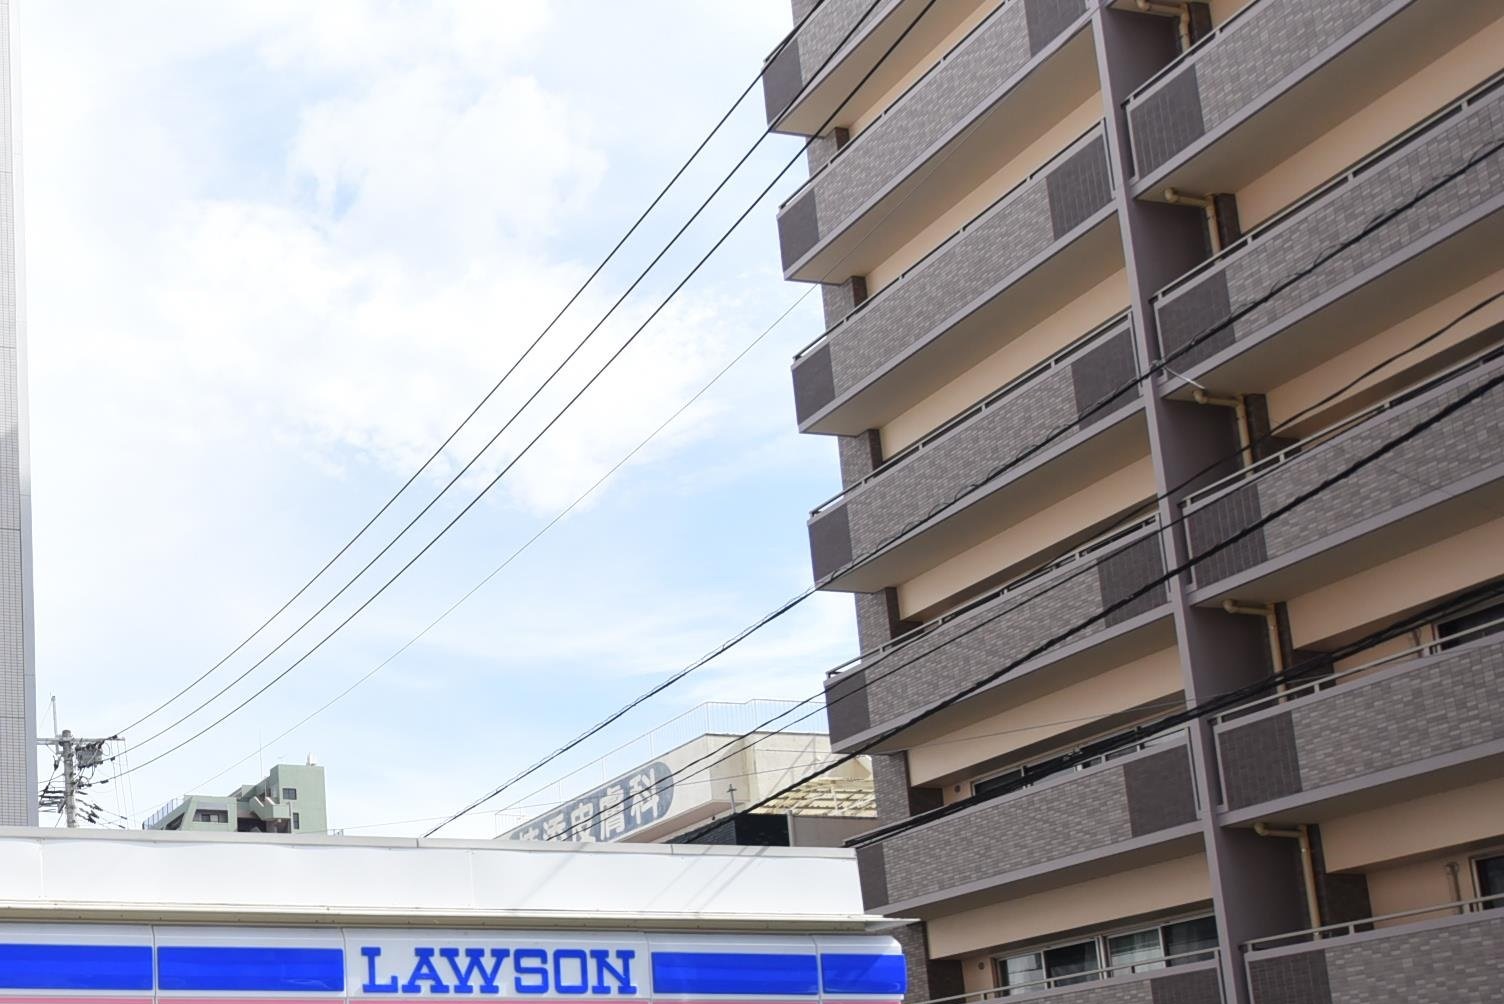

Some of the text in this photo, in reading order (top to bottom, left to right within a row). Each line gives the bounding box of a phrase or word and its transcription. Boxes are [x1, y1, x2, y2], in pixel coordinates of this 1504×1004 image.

[520, 767, 661, 843] 皮膚科
[361, 946, 638, 995] LAWSON
